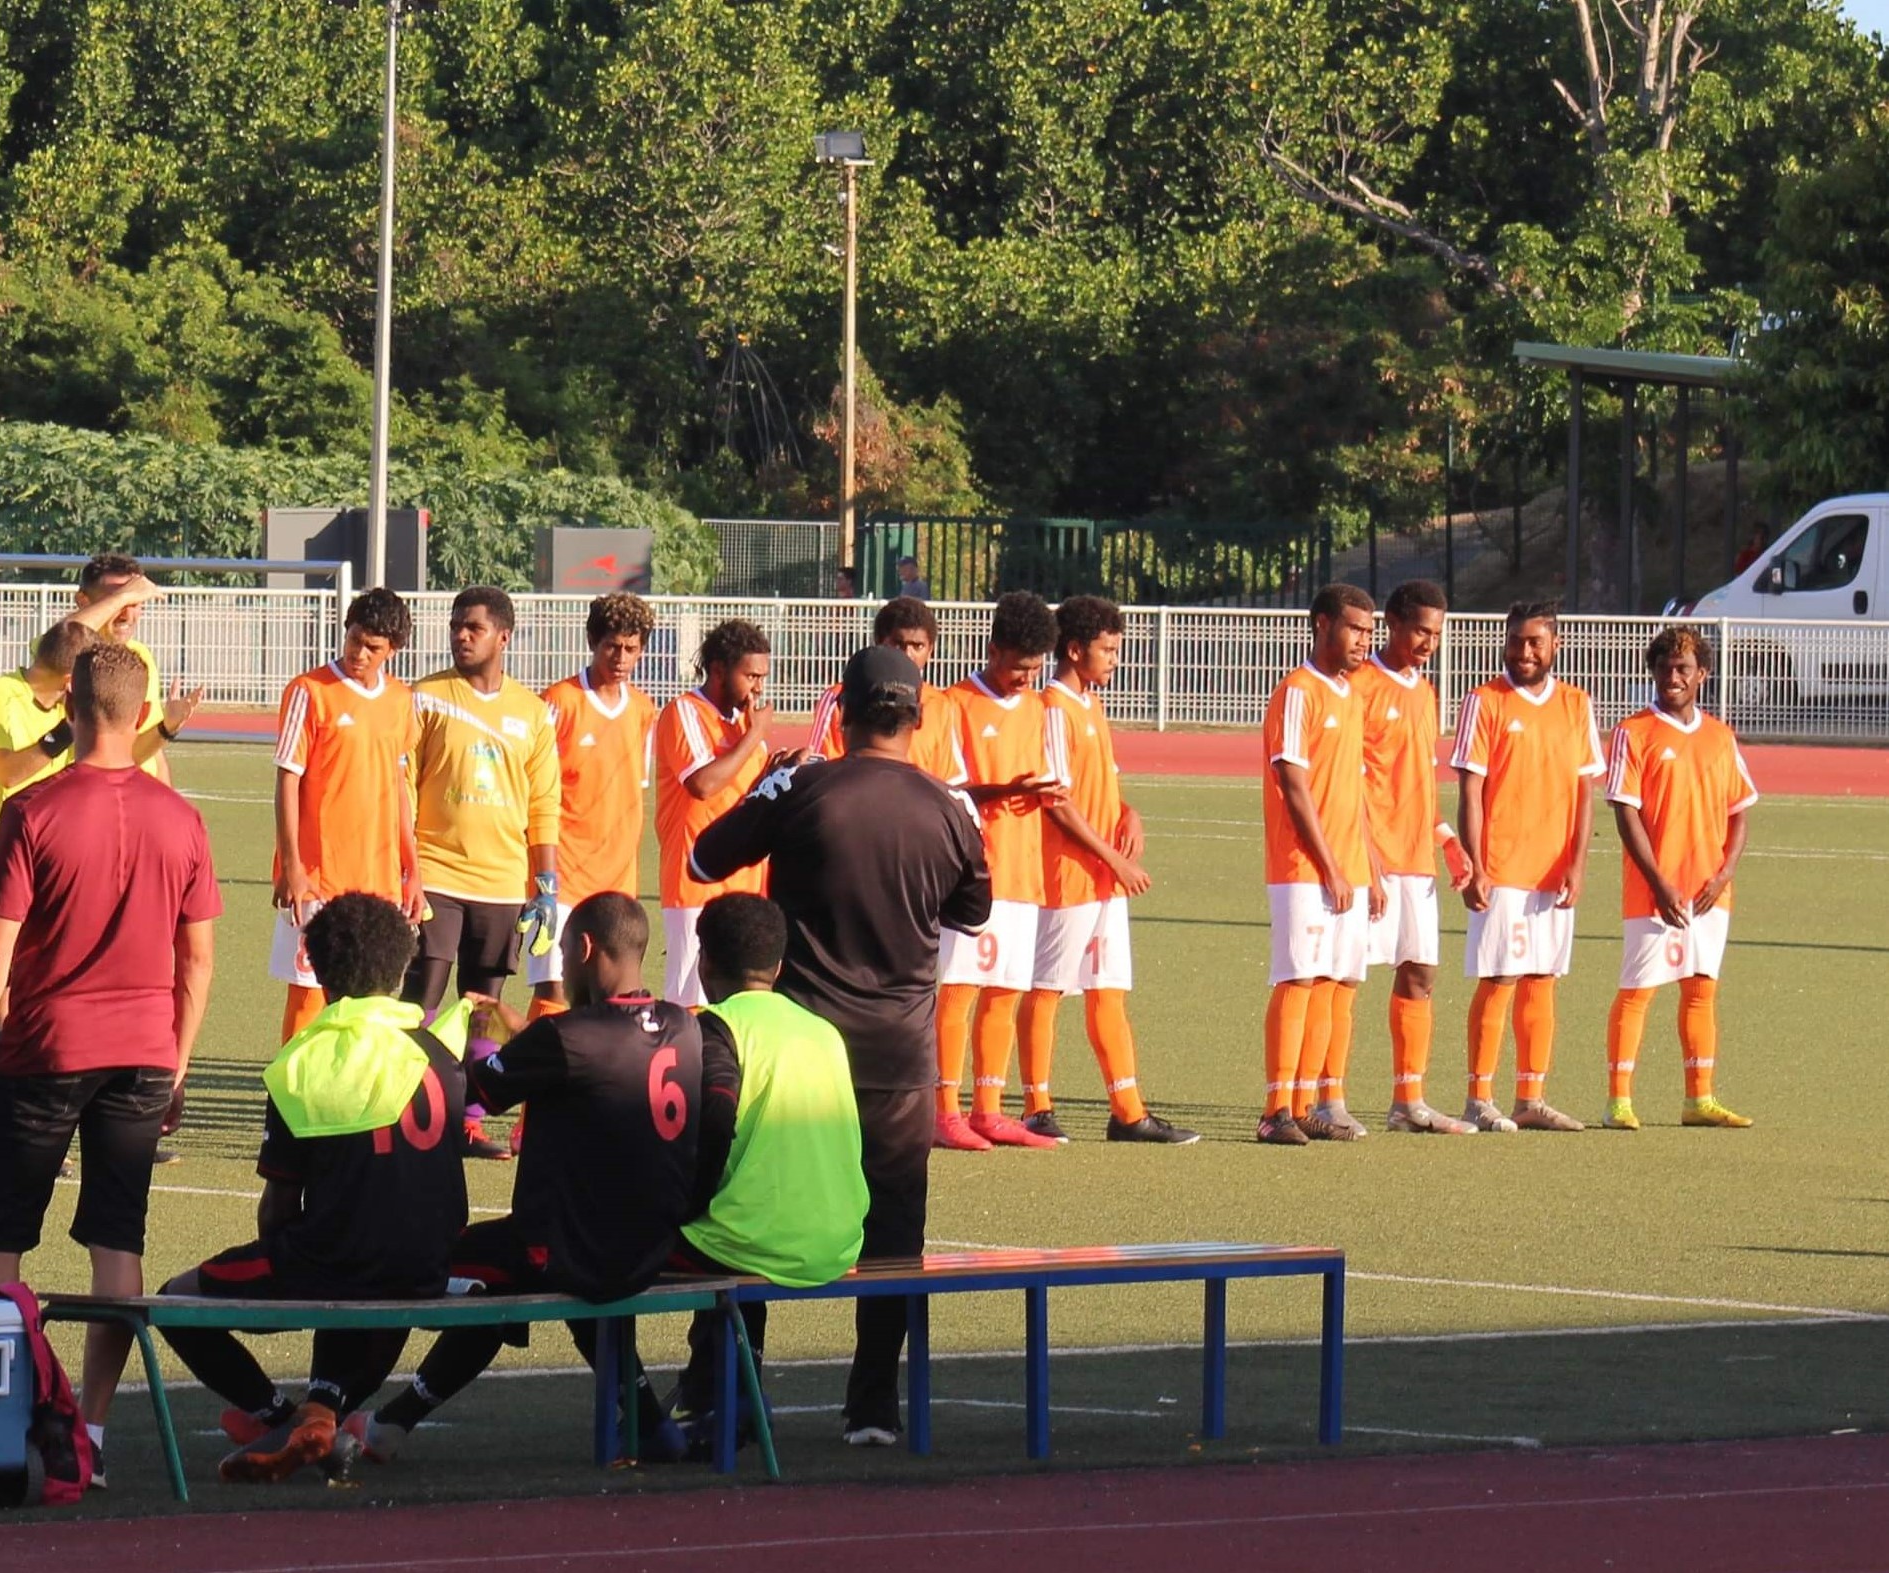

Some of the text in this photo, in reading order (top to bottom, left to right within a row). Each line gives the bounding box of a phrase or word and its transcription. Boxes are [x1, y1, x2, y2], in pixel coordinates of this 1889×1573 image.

[977, 932, 999, 972] 9
[1305, 926, 1325, 964] 7
[1510, 922, 1526, 959] 5
[1664, 931, 1684, 968] 6
[648, 1047, 687, 1141] 6
